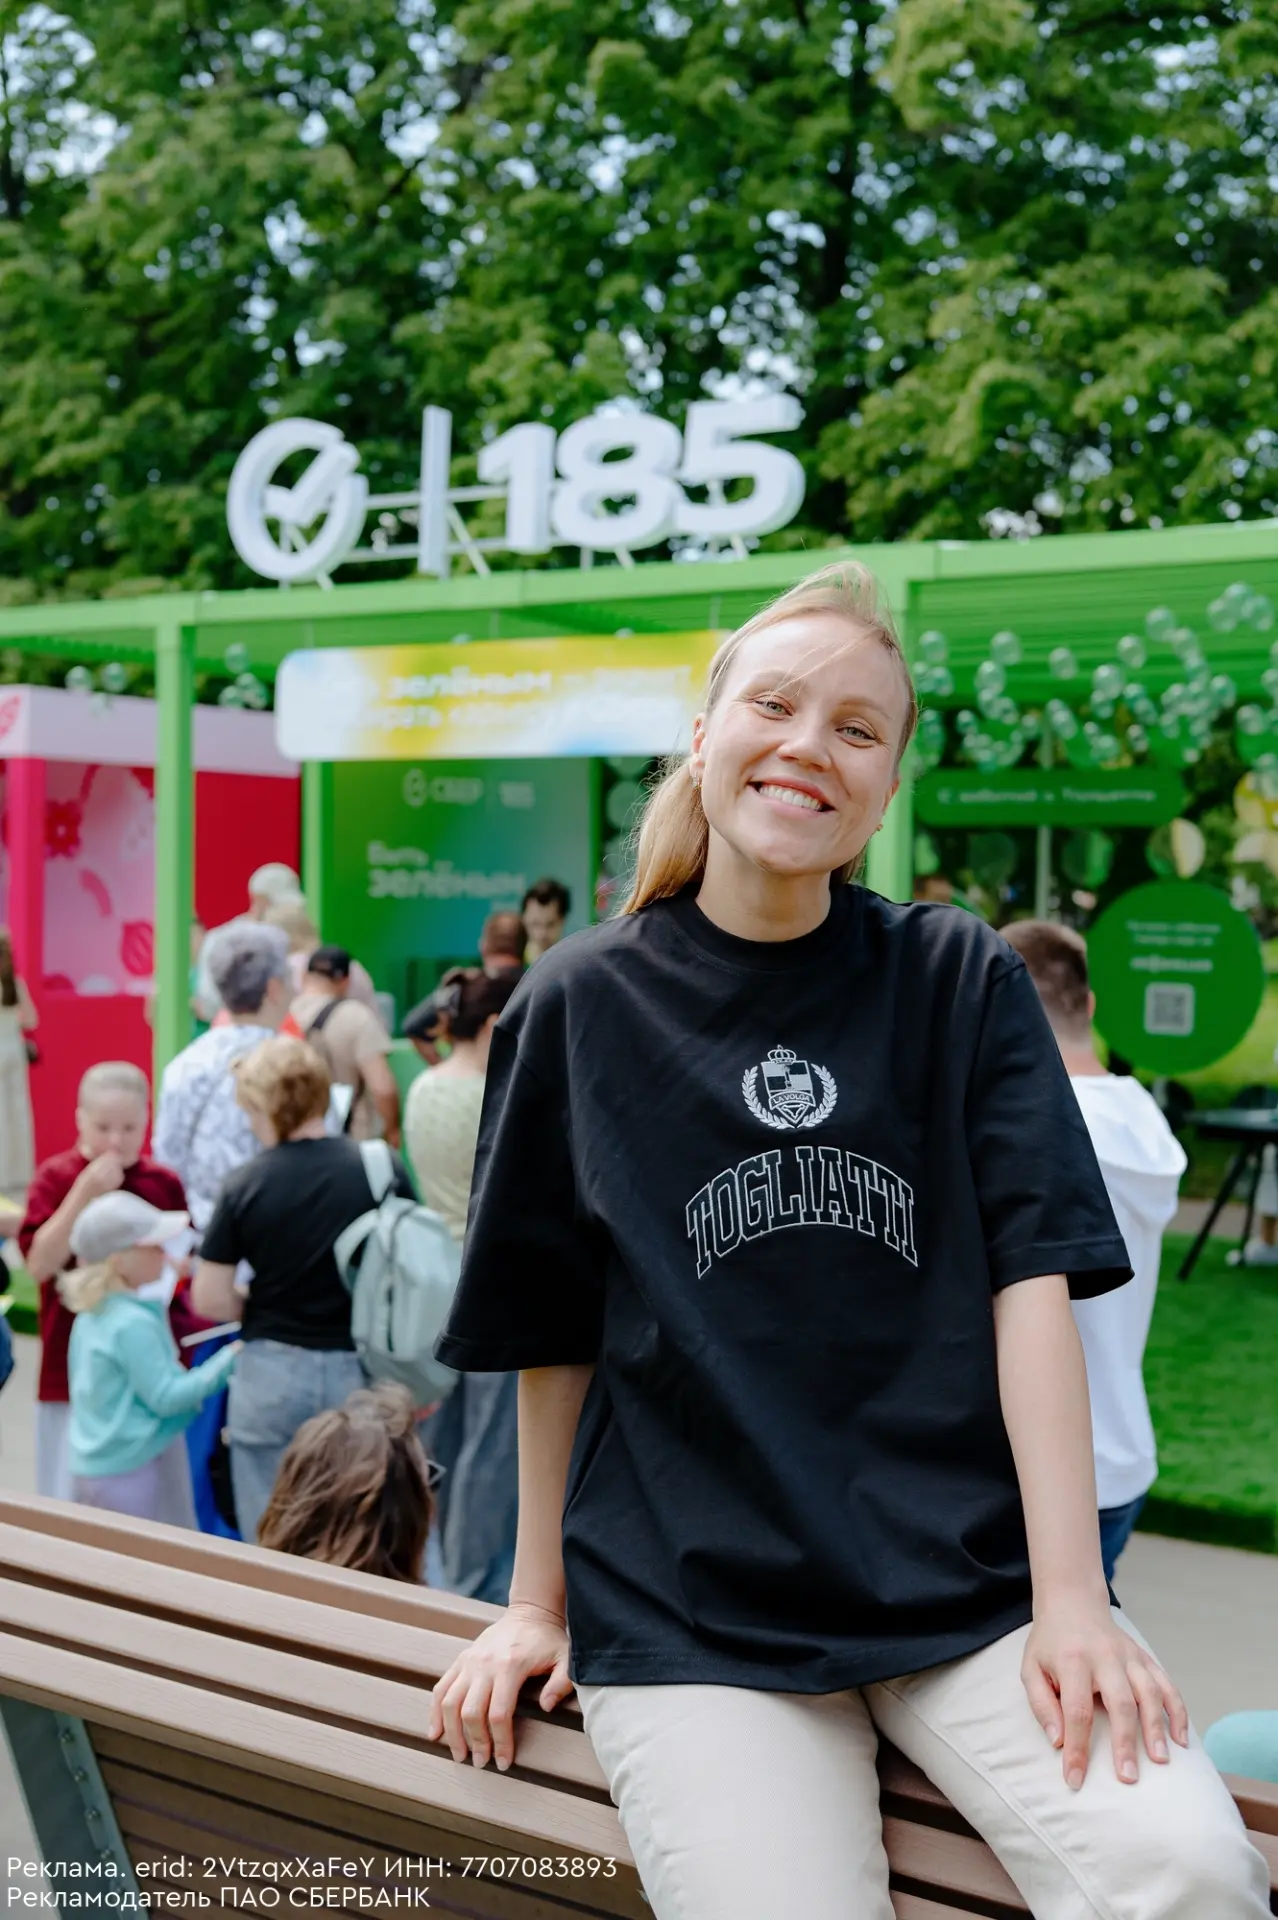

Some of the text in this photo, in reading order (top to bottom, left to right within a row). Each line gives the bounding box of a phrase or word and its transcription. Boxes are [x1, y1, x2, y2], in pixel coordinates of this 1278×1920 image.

[477, 393, 806, 554] 185
[772, 1093, 811, 1104] LA VOLGA
[685, 1145, 919, 1280] TOGLIATTI
